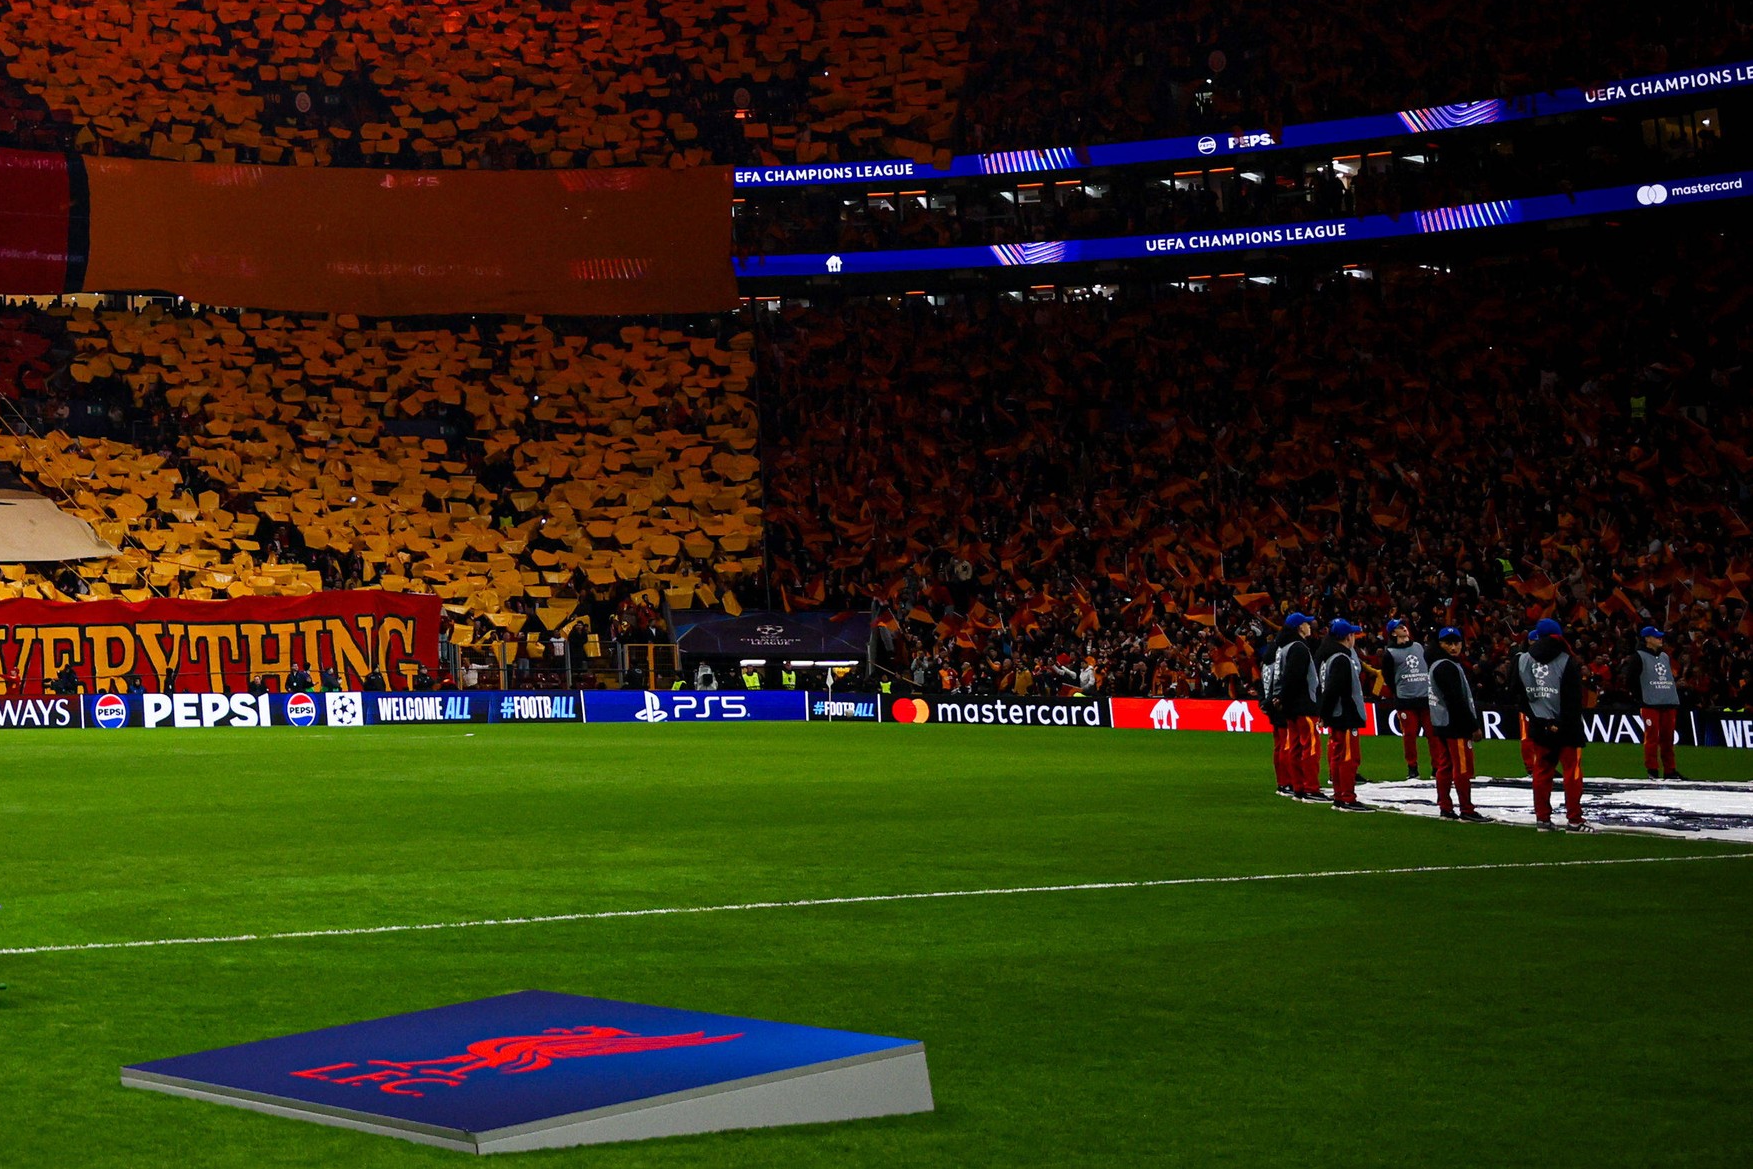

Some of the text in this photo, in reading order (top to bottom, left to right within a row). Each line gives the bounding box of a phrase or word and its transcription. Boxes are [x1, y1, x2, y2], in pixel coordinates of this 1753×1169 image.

[1585, 86, 1626, 103] UEFA
[1630, 69, 1732, 96] CHAMPIONS
[1228, 133, 1276, 149] PEPS
[735, 163, 913, 183] EFA CHAMPIONS LEAGUE
[1672, 178, 1743, 196] mastercard
[1146, 224, 1346, 251] UEFA CHAMPIONS LEAGUE
[97, 706, 125, 717] PEPSI
[145, 693, 271, 727] PEPSI
[288, 705, 316, 716] PEPSI
[378, 696, 471, 720] WELCOME ALL
[501, 695, 576, 719] #FOOTBALL
[673, 696, 746, 718] PS5
[938, 697, 1100, 727] mastercard
